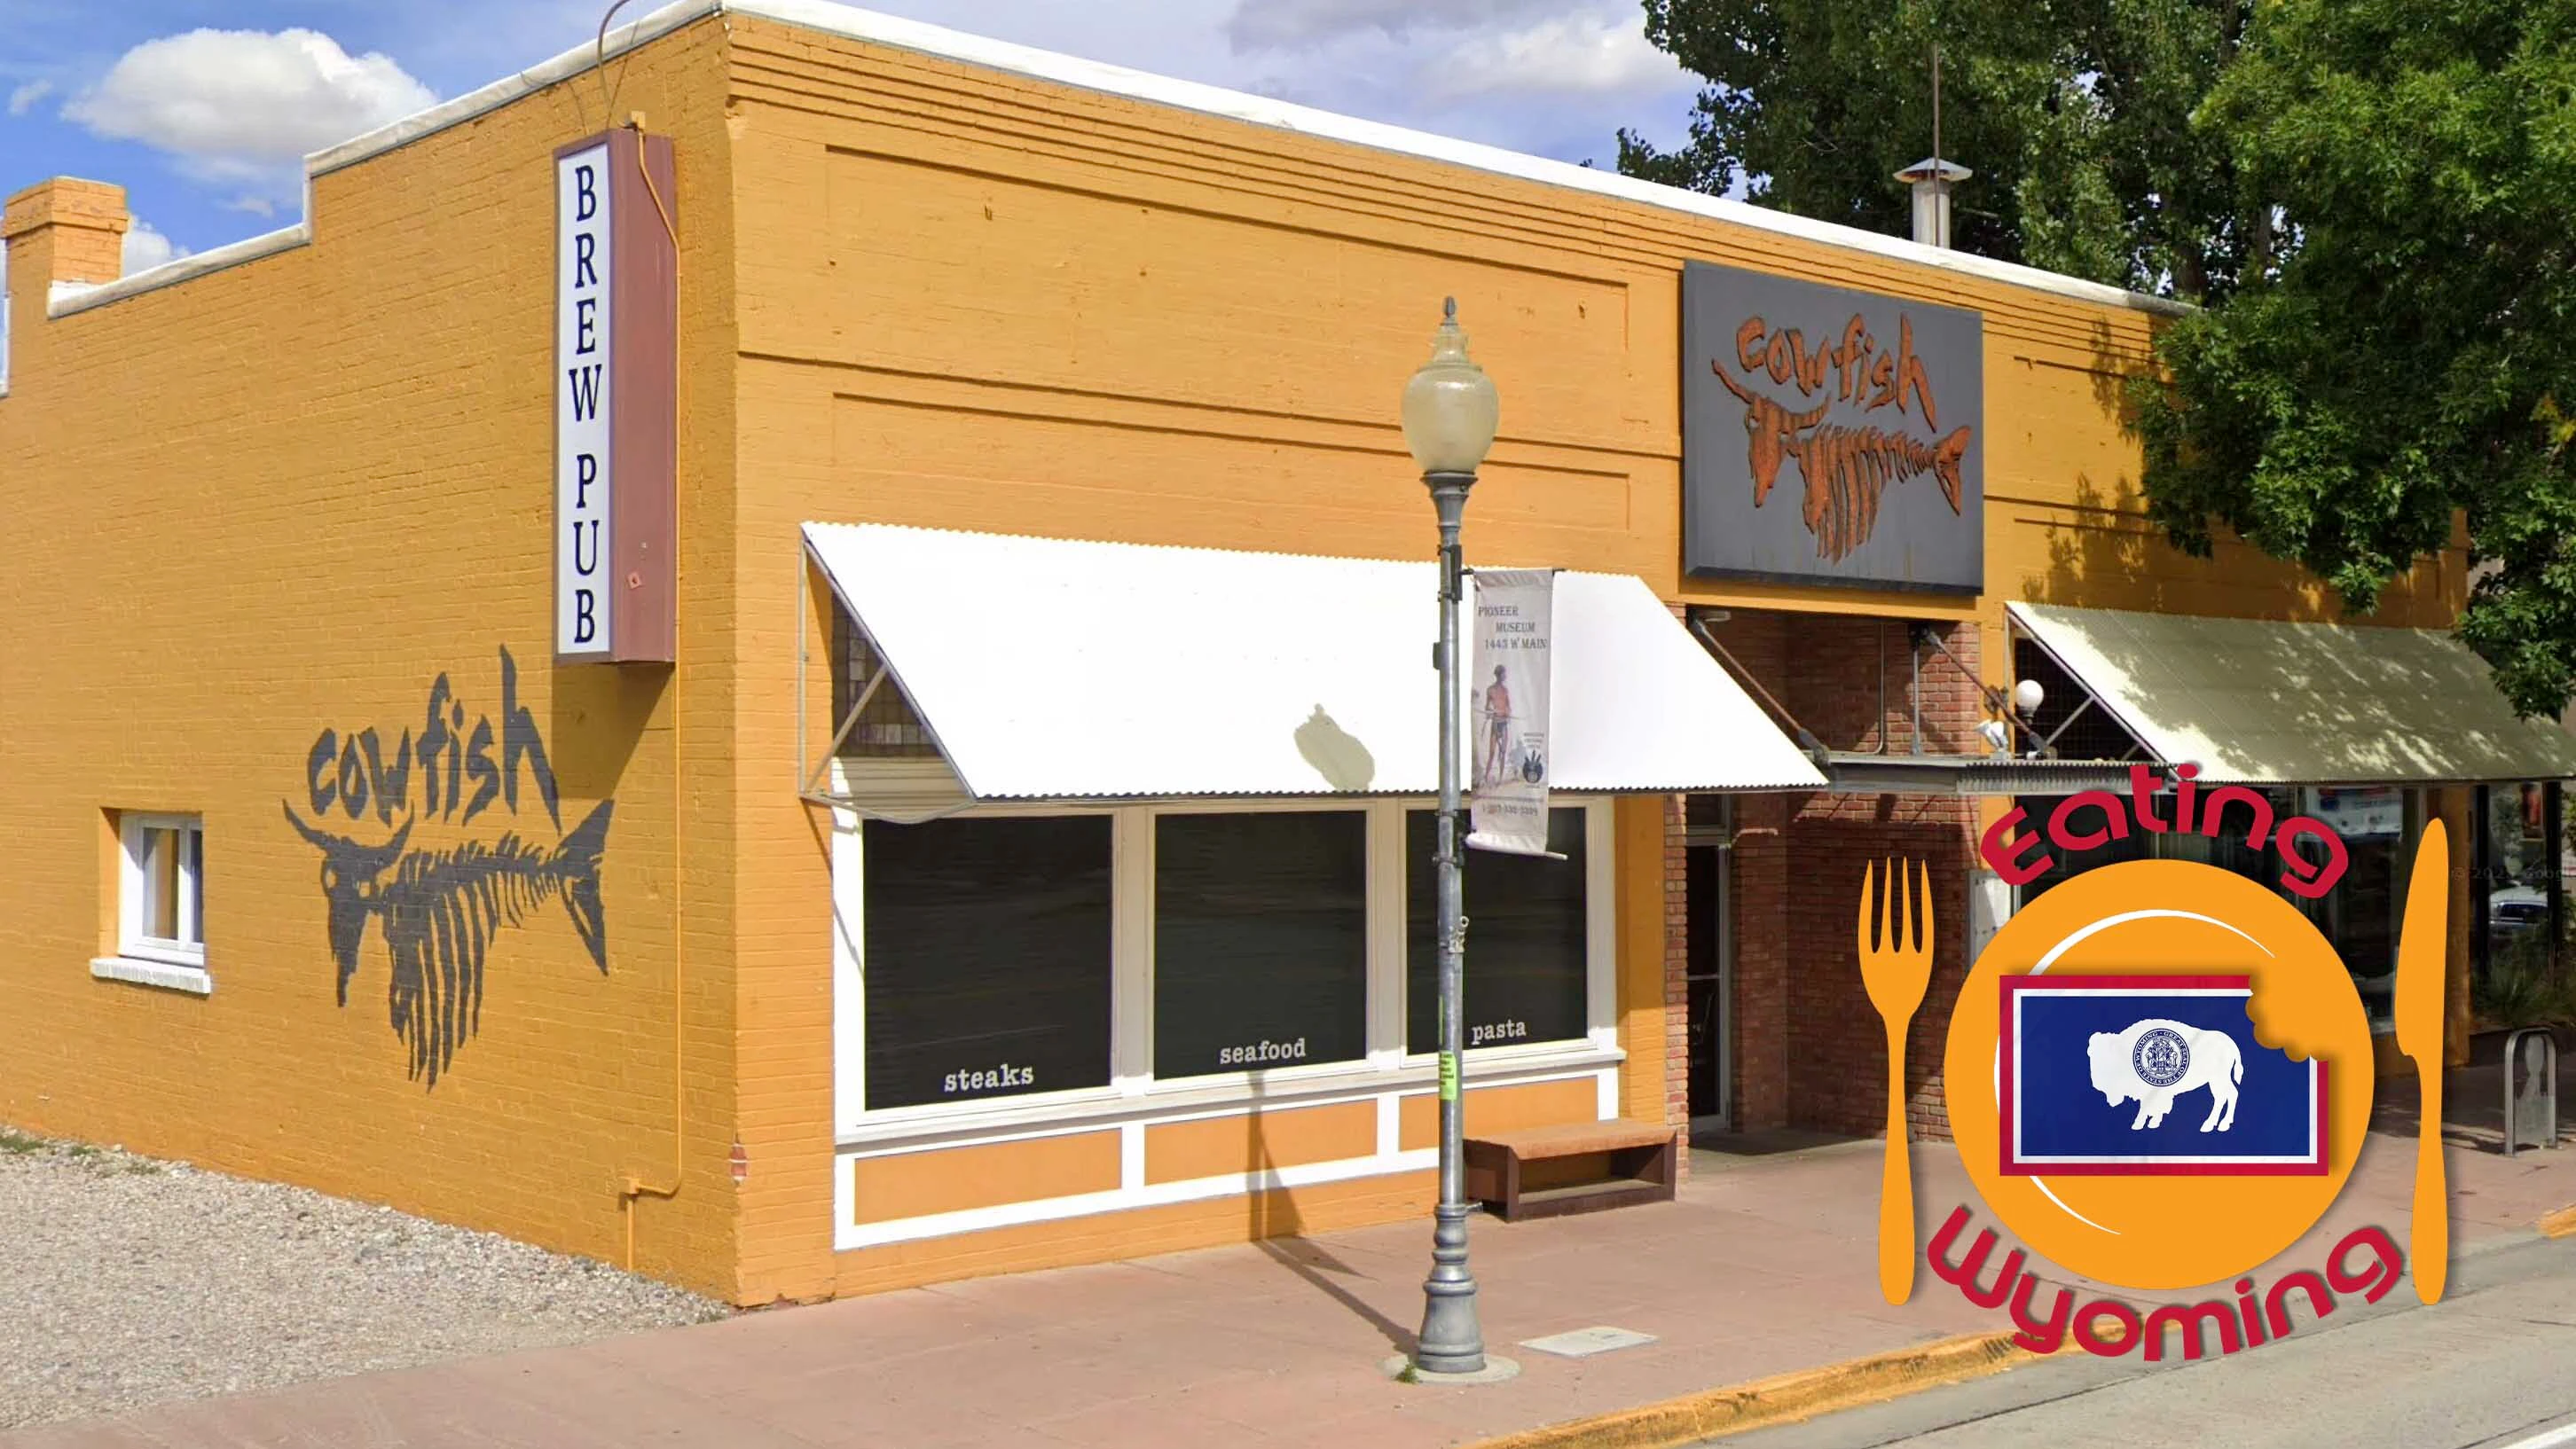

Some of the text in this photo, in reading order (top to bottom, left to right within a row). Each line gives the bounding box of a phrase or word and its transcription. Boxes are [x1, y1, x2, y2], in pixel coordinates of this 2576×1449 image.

[569, 164, 601, 644] BREW PUB
[1478, 606, 1520, 618] PIONEER
[1496, 622, 1535, 632] MUSEUM
[1521, 638, 1548, 649] MAIN
[1471, 1017, 1528, 1046] pasta
[1219, 1038, 1307, 1065] seafood
[943, 1063, 1035, 1094] steaks
